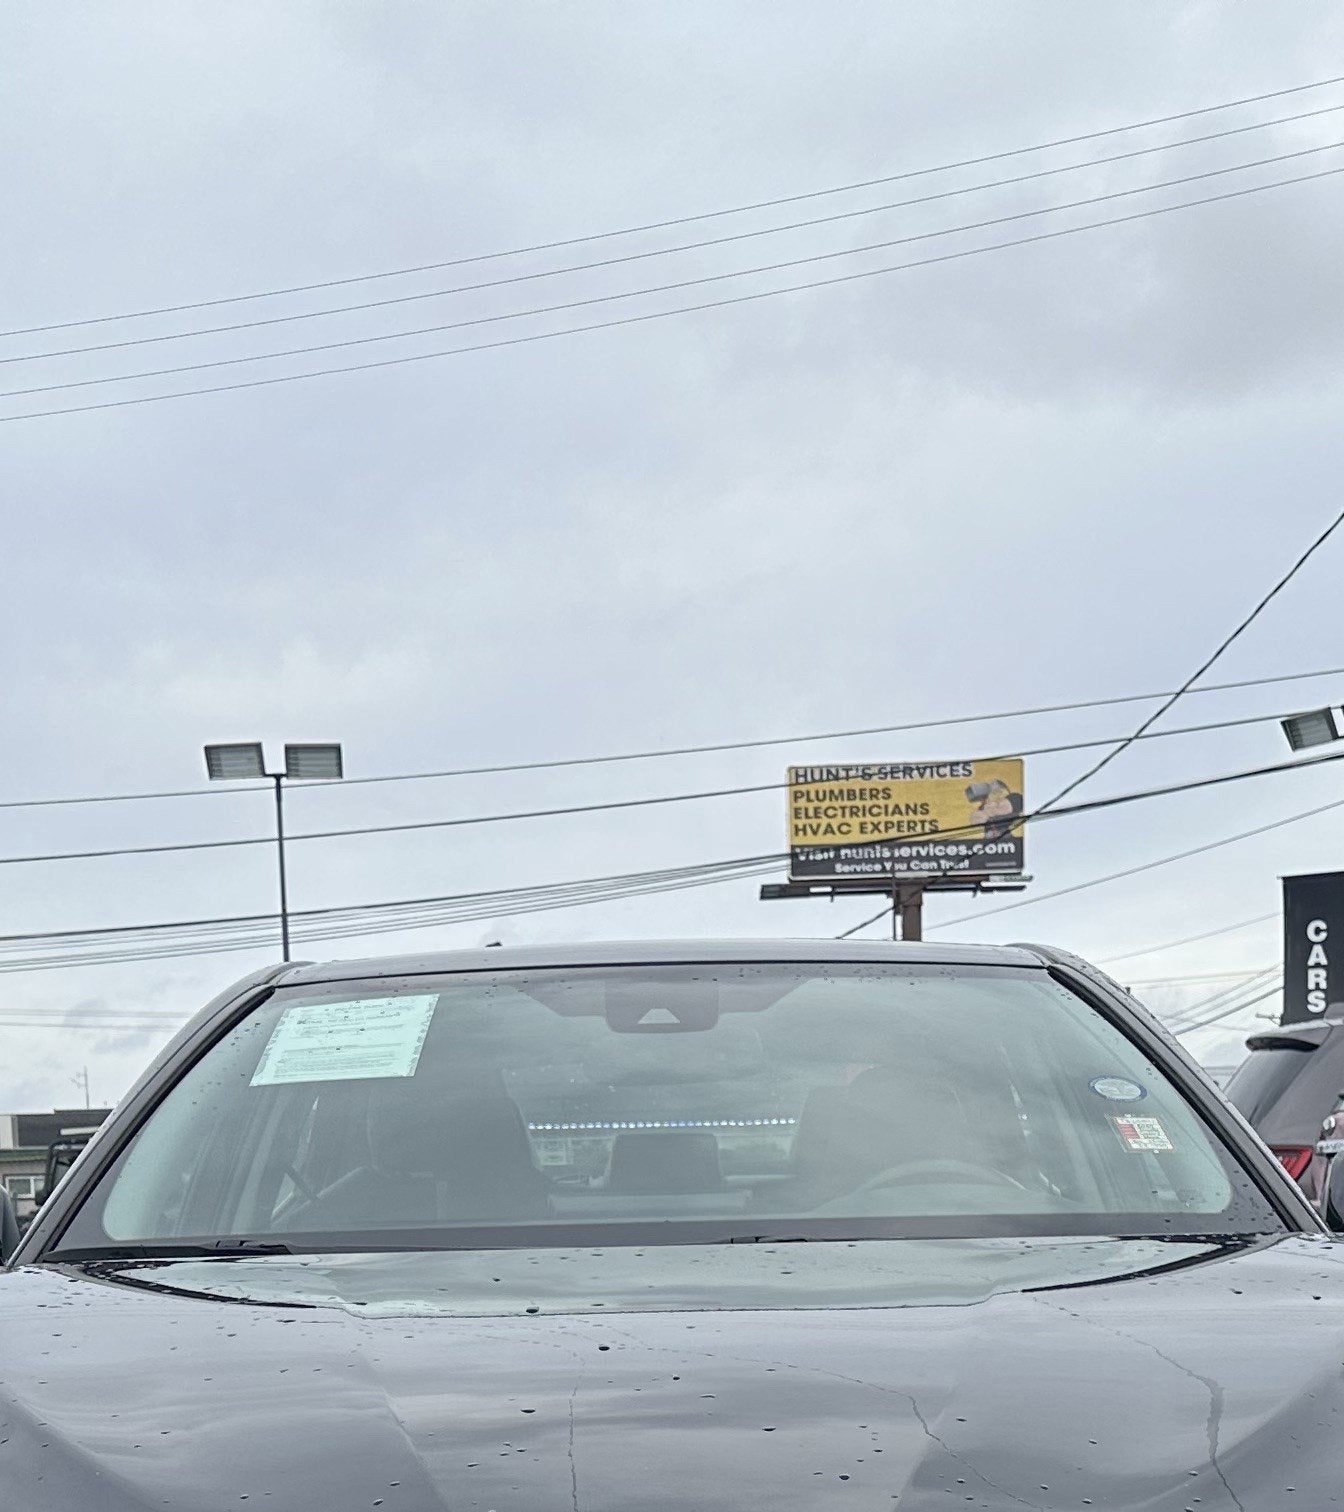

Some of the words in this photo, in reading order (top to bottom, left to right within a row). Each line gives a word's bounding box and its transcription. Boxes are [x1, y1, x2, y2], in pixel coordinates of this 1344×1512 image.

[878, 763, 973, 780] SERVICES
[793, 788, 891, 802] PLUMBERS
[793, 803, 930, 819] ELECTRICIANS
[794, 823, 852, 836] HVAC
[859, 819, 939, 834] EXPERTS
[835, 863, 882, 873] Service
[910, 861, 938, 870] Can
[1306, 919, 1328, 1013] CARS
